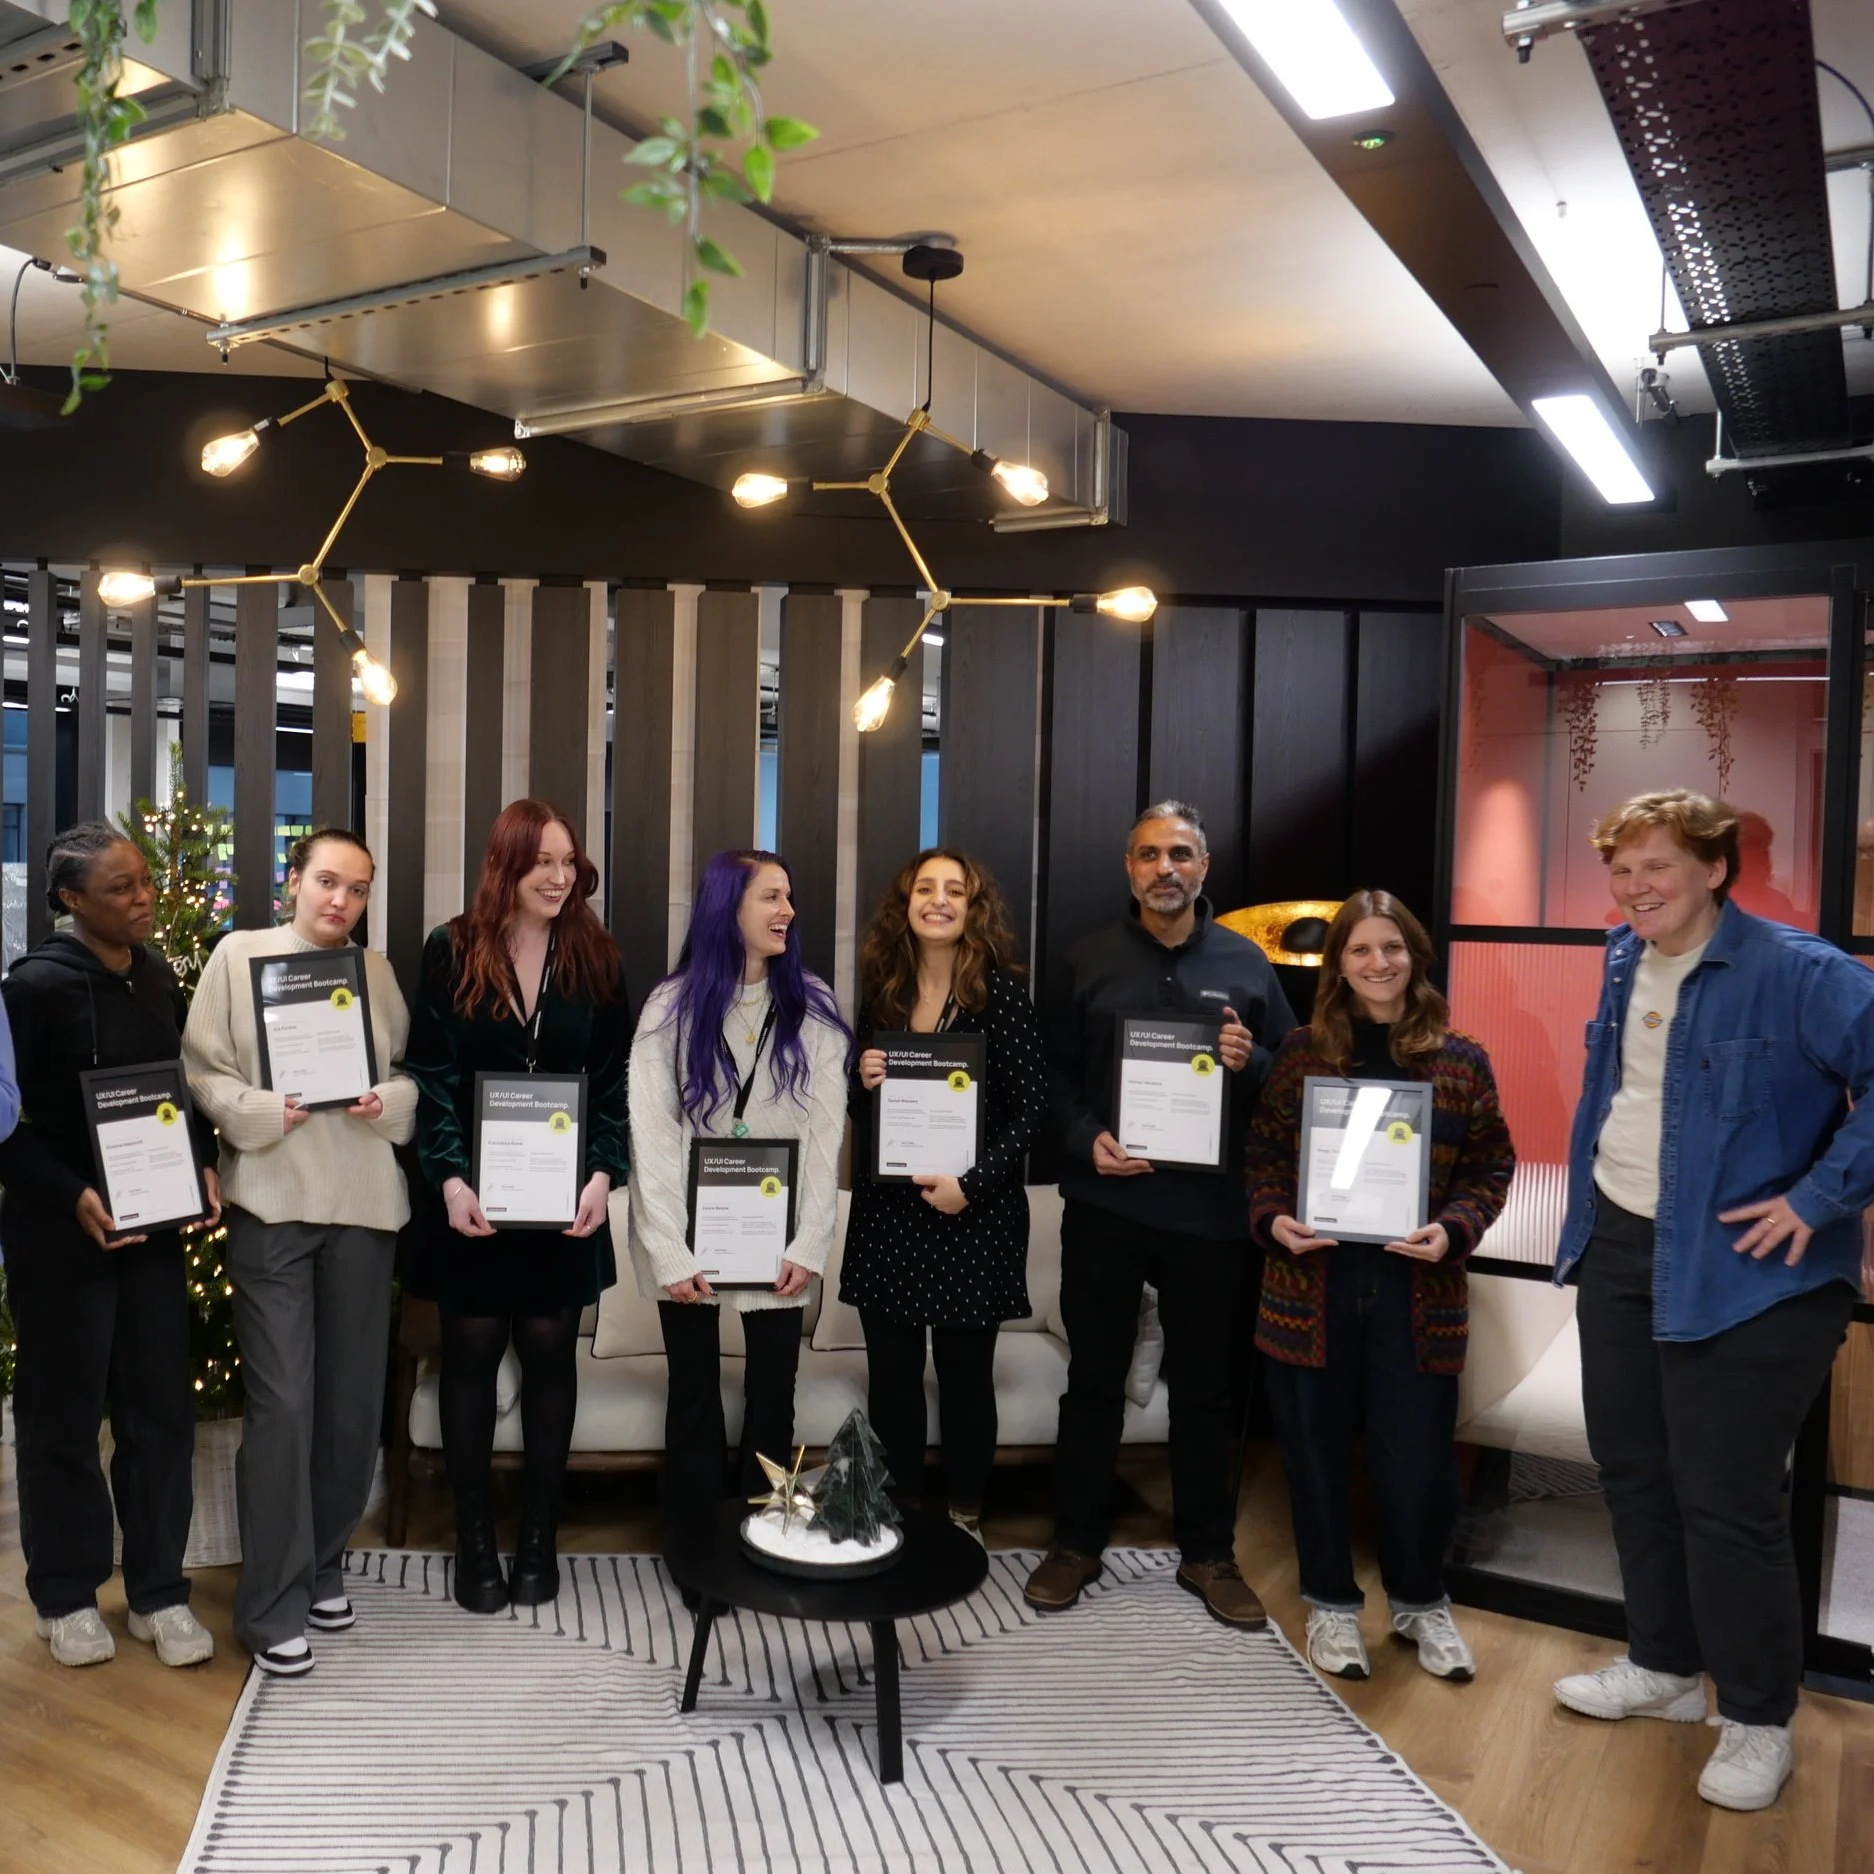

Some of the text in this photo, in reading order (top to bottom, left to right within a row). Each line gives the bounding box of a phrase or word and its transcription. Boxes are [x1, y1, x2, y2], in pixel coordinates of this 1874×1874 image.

[290, 973, 311, 982] Career
[314, 978, 349, 989] Bootcamp.
[1130, 1031, 1176, 1040] UX/UI Career
[1130, 1040, 1214, 1052] Development Bootcamp.
[888, 1059, 969, 1068] Development Bootcamp.
[96, 1088, 138, 1100] UX/UI Career
[490, 1092, 510, 1100] UX/UI
[98, 1092, 172, 1109] Development Bootcamp.
[490, 1100, 570, 1110] Development Bootcamp.
[704, 1166, 780, 1174] Development Bootcamp.
